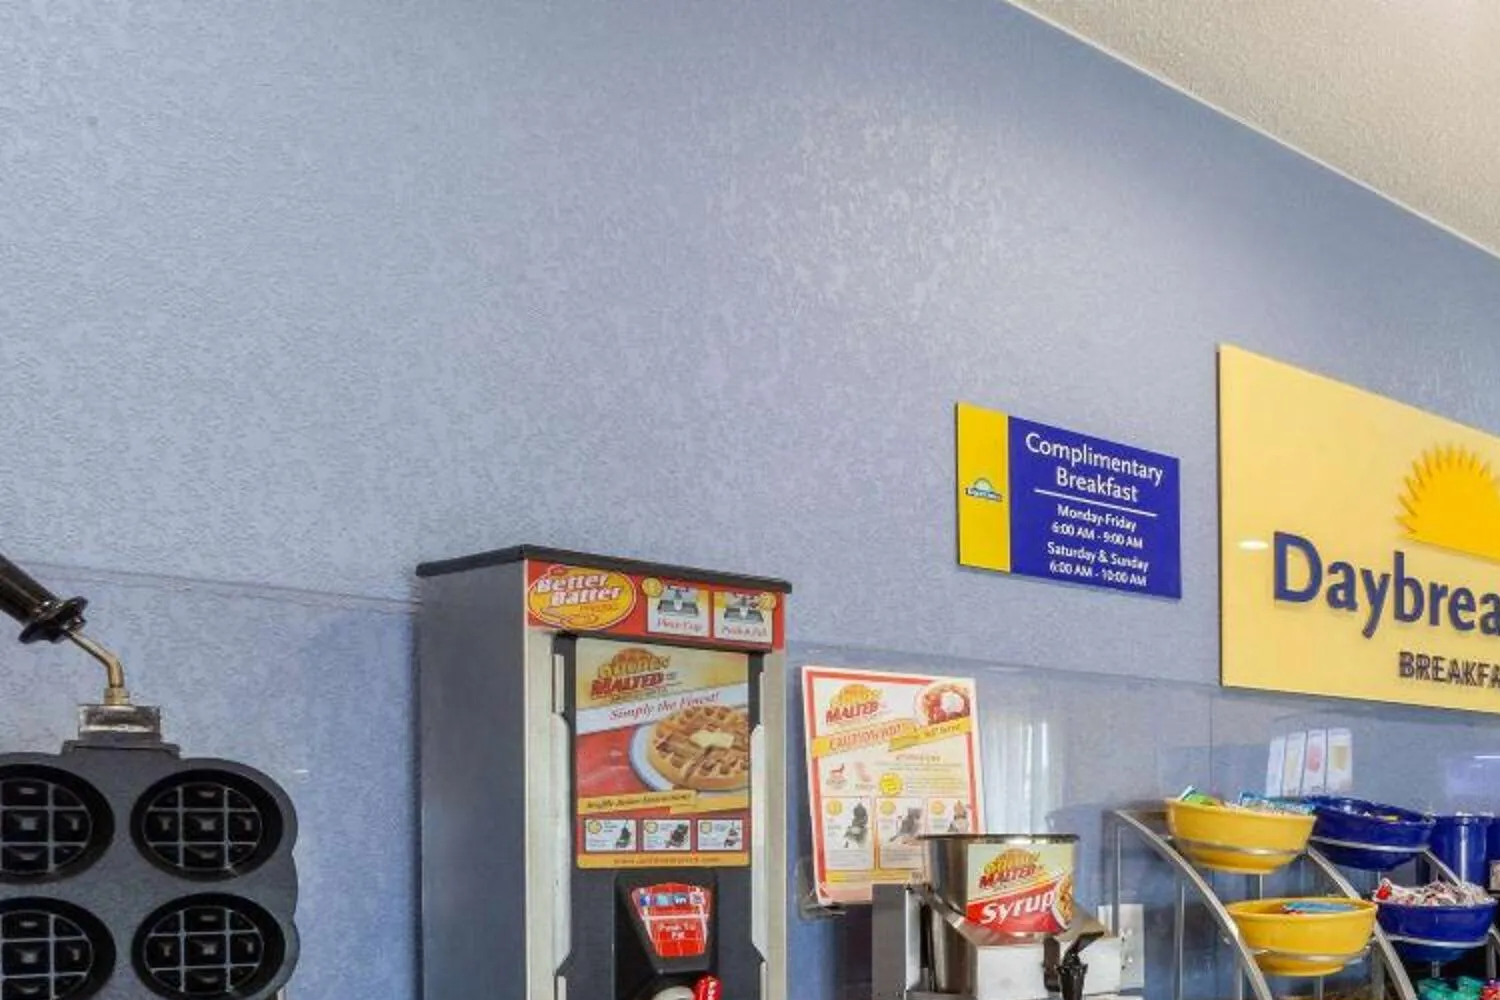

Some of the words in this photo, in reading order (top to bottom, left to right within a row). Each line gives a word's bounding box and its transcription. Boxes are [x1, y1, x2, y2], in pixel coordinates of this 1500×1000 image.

[1025, 432, 1164, 487] Complimentary
[1056, 466, 1139, 502] Breakfast
[1057, 504, 1137, 532] Monday-Friday
[1052, 522, 1075, 537] 6:00
[1078, 526, 1095, 540] AM
[1103, 530, 1125, 545] 9:00
[1126, 534, 1143, 549] AM
[1047, 542, 1096, 564] Saturday
[1111, 553, 1149, 573] Sunday
[536, 573, 609, 593] Better
[1074, 563, 1093, 577] AM
[1102, 568, 1128, 584] 10:00
[1129, 571, 1147, 586] AM
[551, 587, 623, 607] Batter
[609, 703, 653, 721] Simply
[657, 701, 677, 713] the
[980, 888, 1056, 925] Syrup
